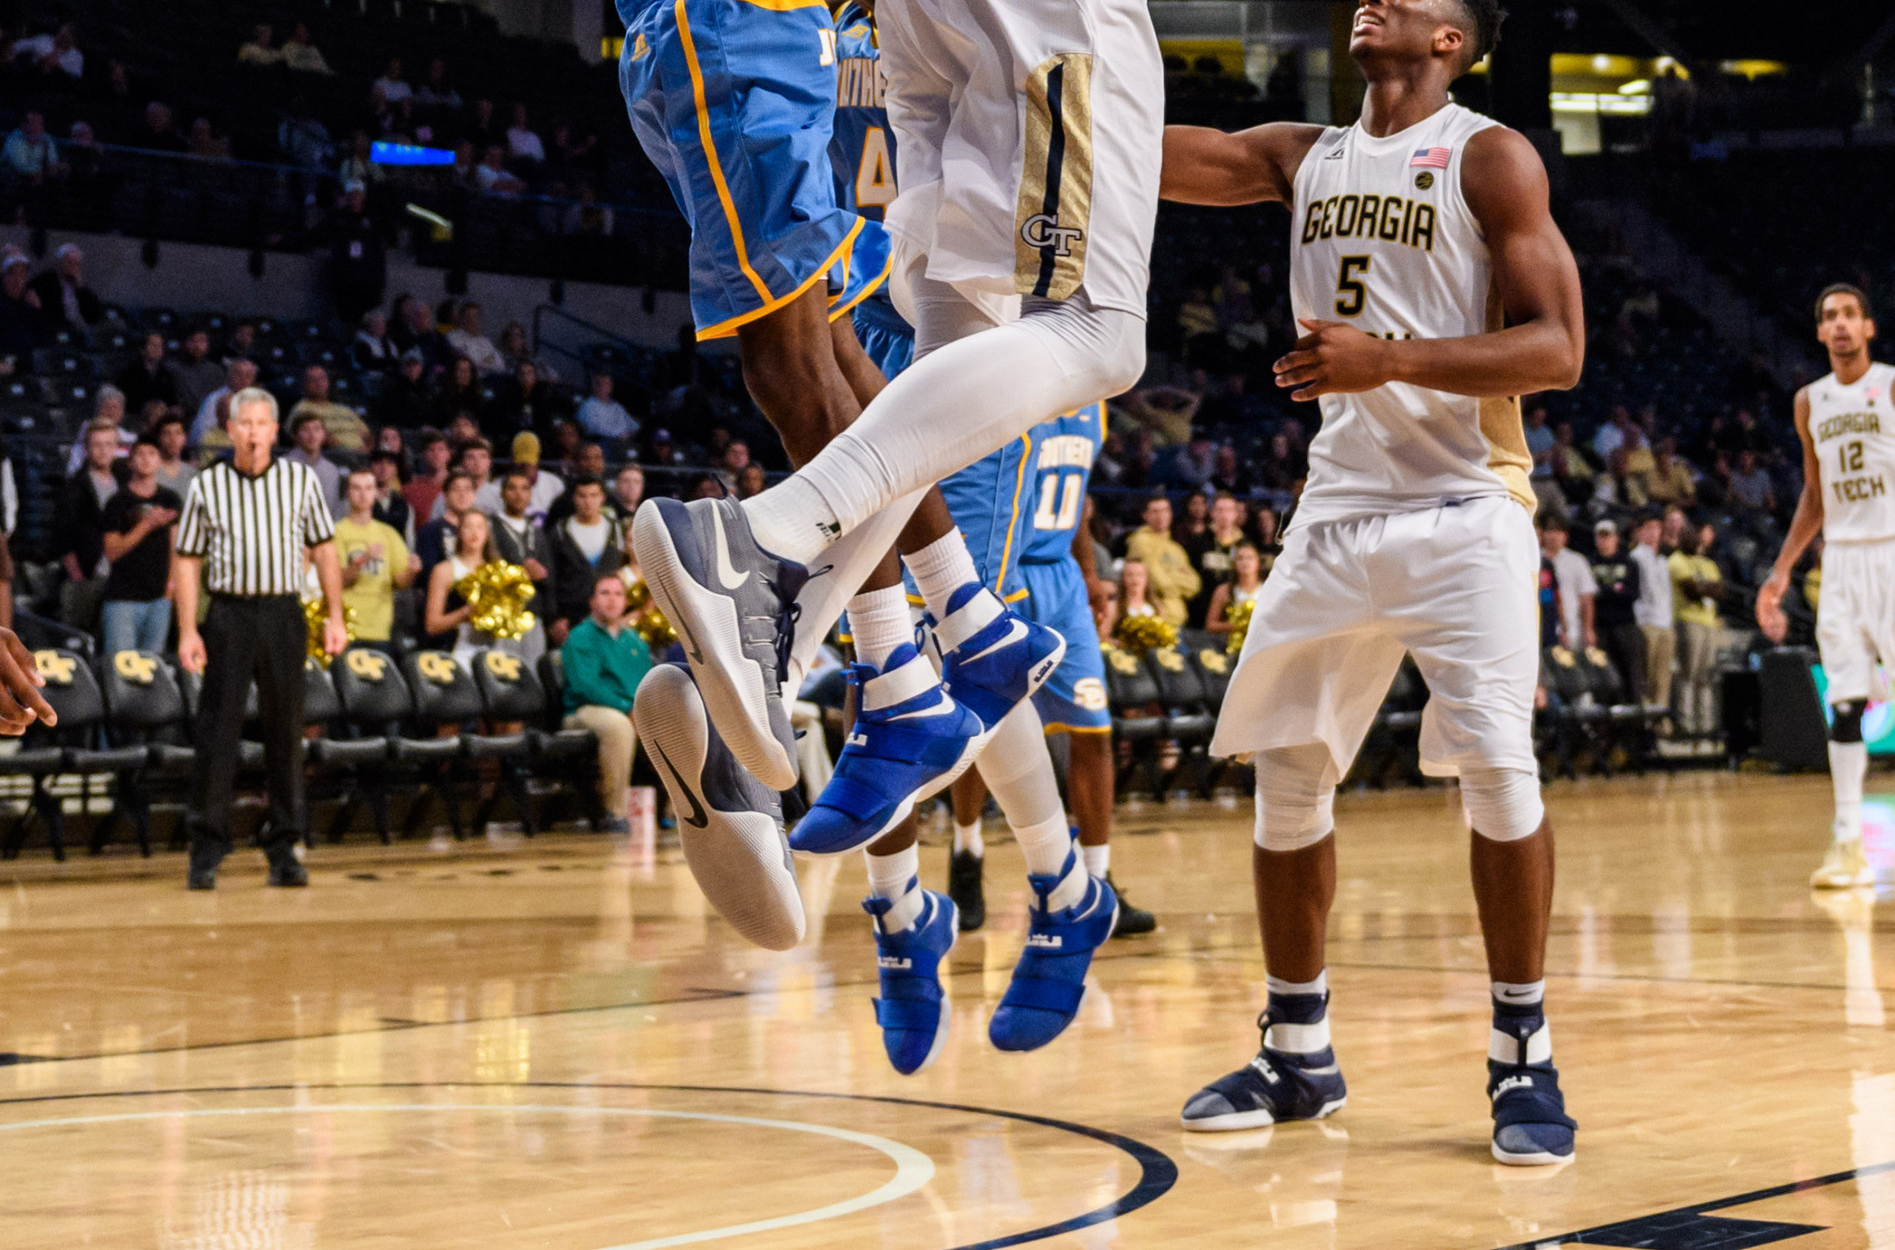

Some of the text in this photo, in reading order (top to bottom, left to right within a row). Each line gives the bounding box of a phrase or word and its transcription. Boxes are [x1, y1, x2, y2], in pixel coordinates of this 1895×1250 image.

[855, 126, 898, 220] 4
[1301, 195, 1436, 251] GEORGIA
[1335, 255, 1370, 318] 5
[1818, 413, 1880, 443] GEORGIA
[1838, 440, 1865, 475] 12
[1033, 474, 1082, 530] 10
[1832, 475, 1886, 503] TECH
